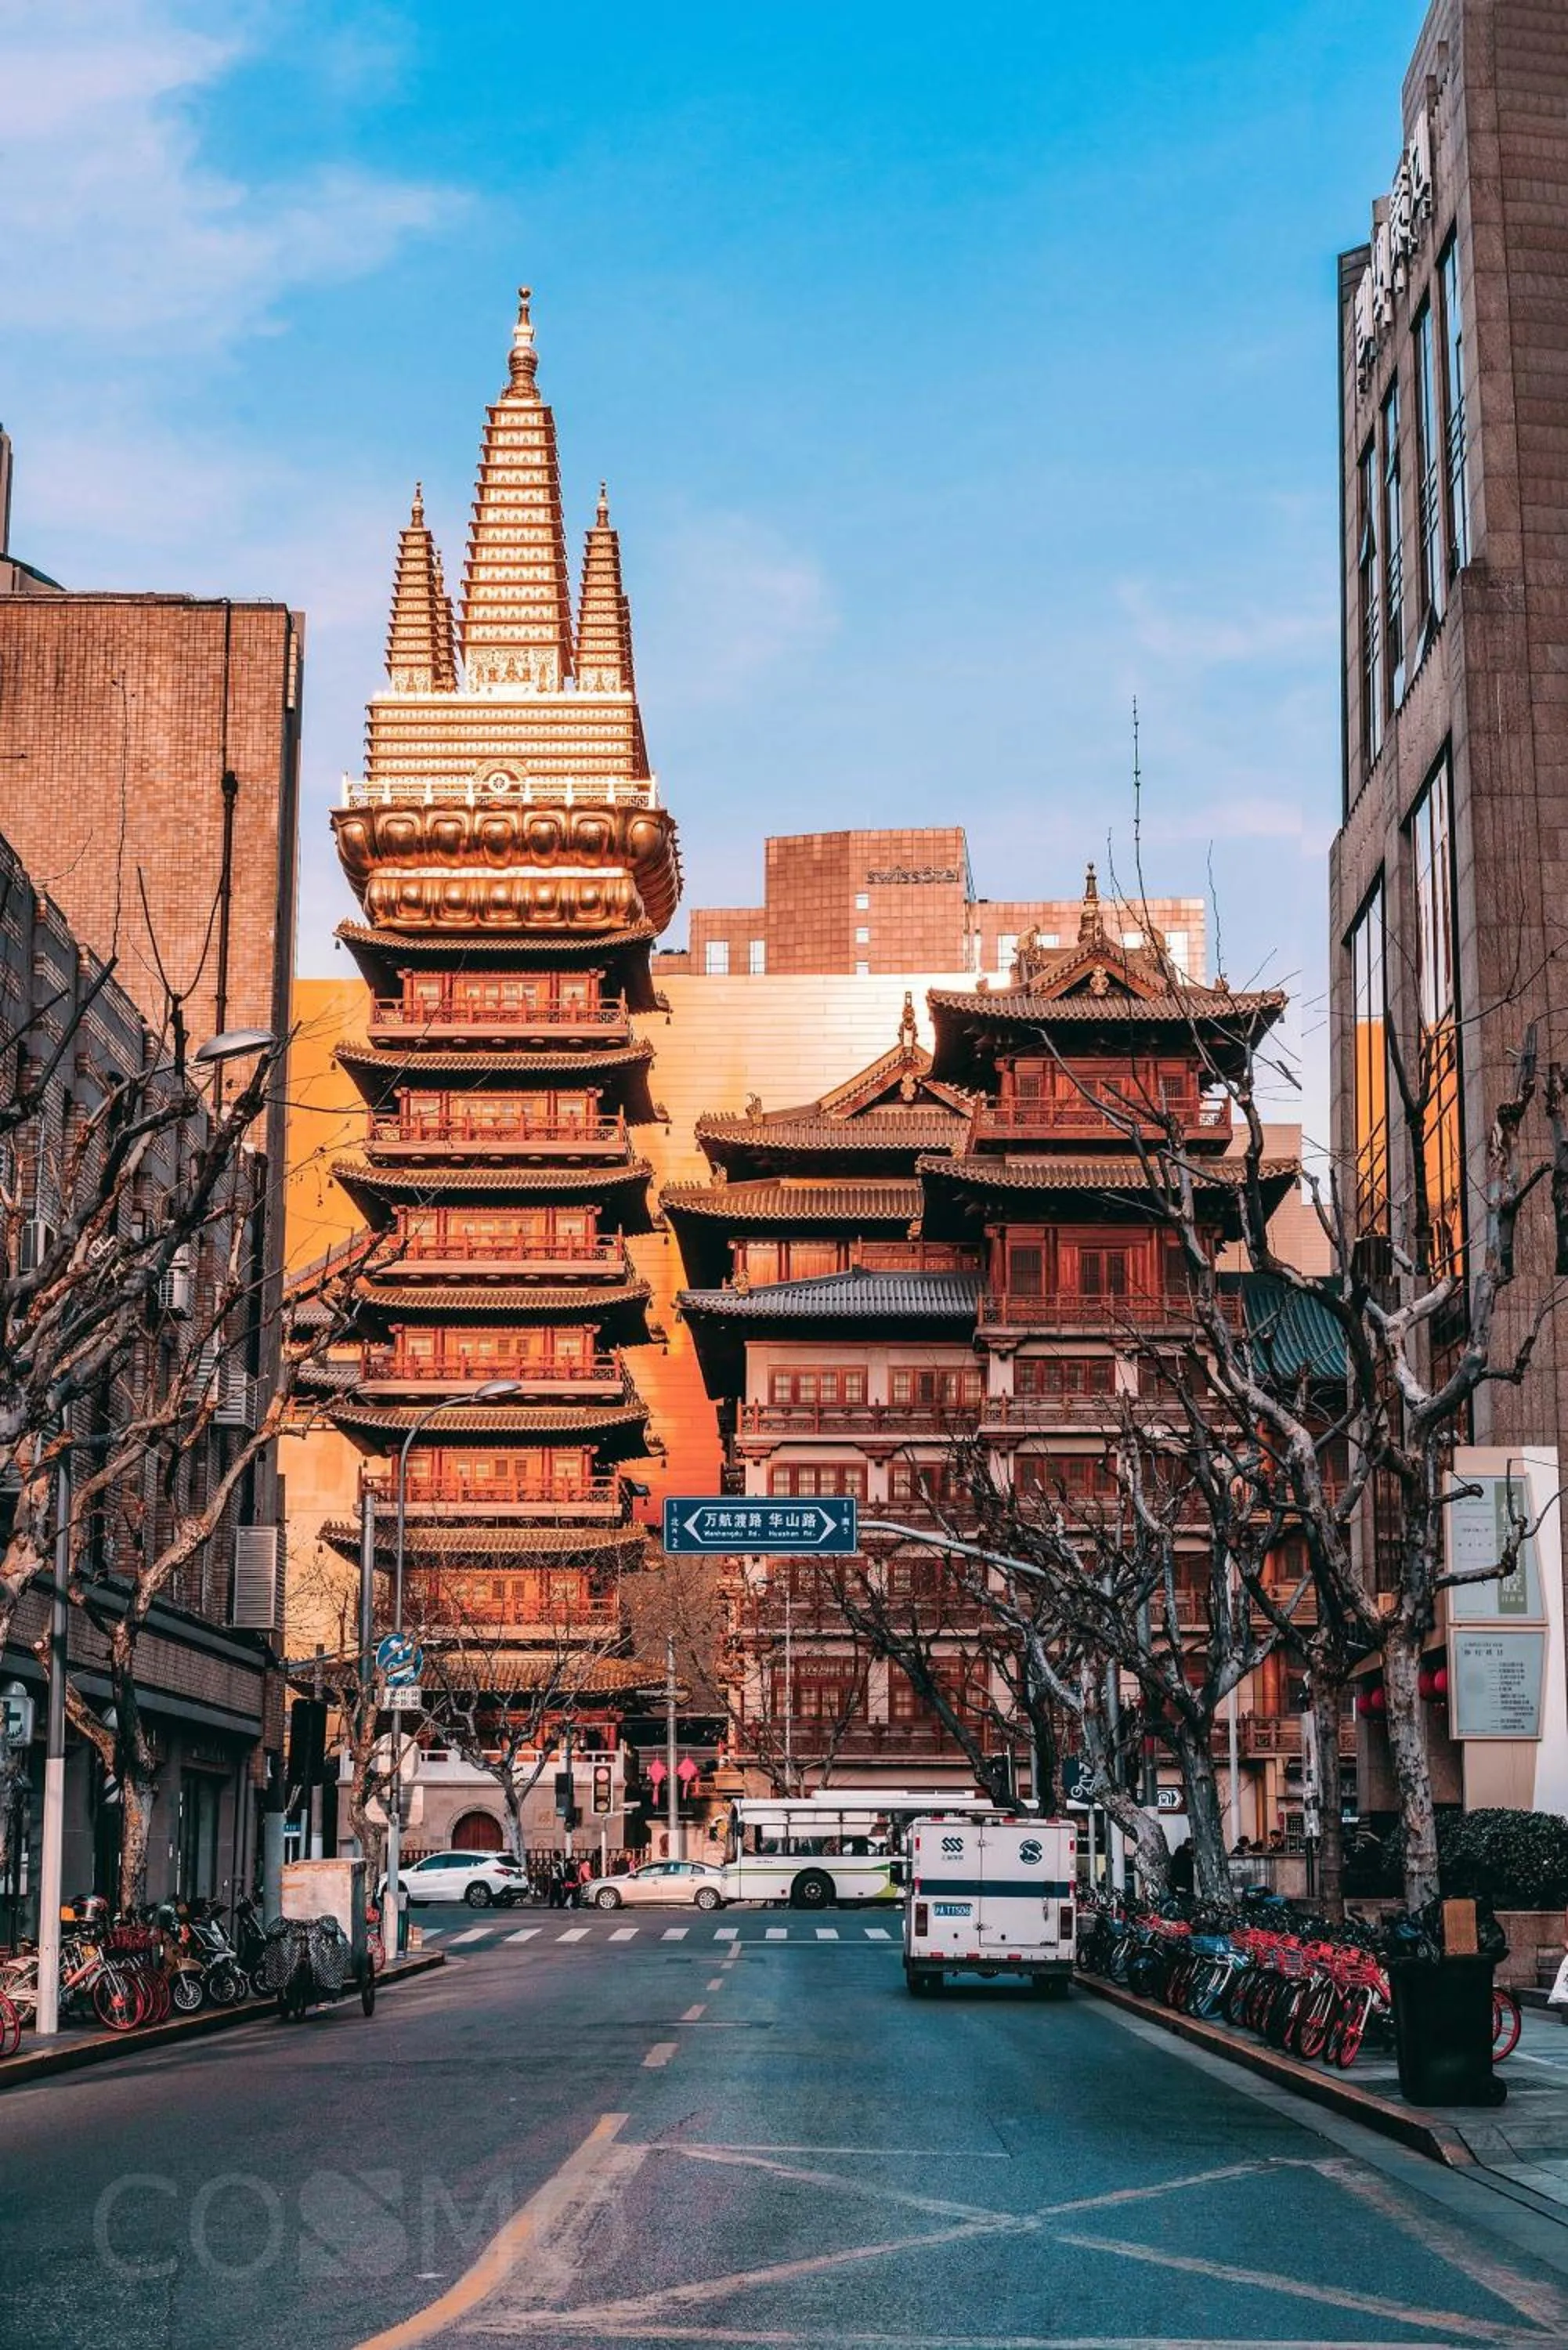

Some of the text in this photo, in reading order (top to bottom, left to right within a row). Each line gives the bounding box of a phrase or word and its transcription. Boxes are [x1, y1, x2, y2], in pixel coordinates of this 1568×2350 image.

[704, 1513, 817, 1528] 万航渡路 华山路
